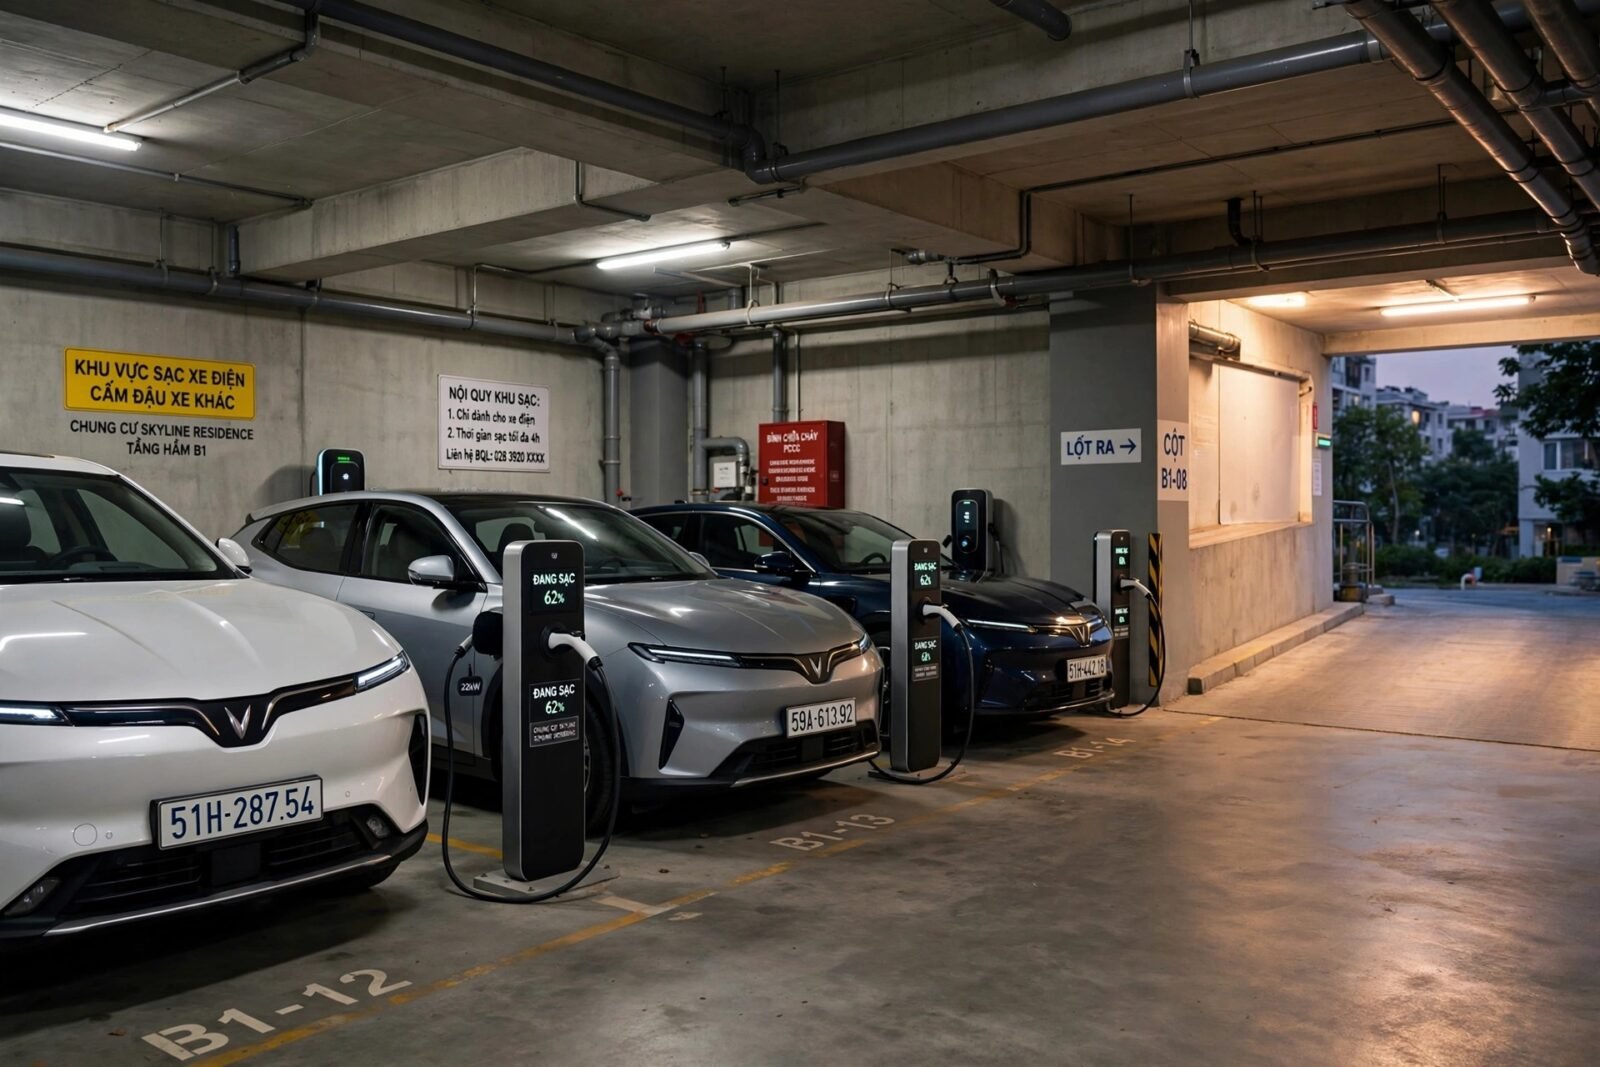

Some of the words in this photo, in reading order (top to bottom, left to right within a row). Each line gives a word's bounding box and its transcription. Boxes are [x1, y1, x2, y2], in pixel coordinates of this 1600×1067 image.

[75, 359, 110, 377] KHU
[115, 362, 149, 383] VỰC
[153, 366, 185, 385] SẠC
[189, 368, 207, 385] XE
[212, 368, 245, 390] ĐIỆN
[90, 380, 128, 403] CẤM
[133, 386, 166, 408] ĐẬU
[171, 391, 190, 407] XE
[195, 391, 235, 410] KHÁC
[449, 384, 468, 403] NỘI
[470, 389, 492, 402] QUY
[495, 391, 515, 405] KHU
[518, 393, 540, 409] SẠC:
[448, 408, 455, 420] 1.
[493, 411, 506, 423] cho
[508, 415, 517, 424] xe
[70, 420, 116, 435] CHUNG
[120, 421, 138, 435] CƯ
[141, 423, 190, 437] SKYLINE
[193, 426, 254, 440] RESIDENCE
[447, 427, 455, 439] 2.
[531, 433, 540, 443] 4h
[194, 445, 206, 456] B1
[1096, 439, 1115, 455] RA
[1163, 427, 1185, 462] CỘT
[508, 451, 525, 462] 3920
[1161, 467, 1187, 490] B1-08
[532, 573, 557, 586] ĐANG
[558, 572, 576, 587] SẠC
[544, 590, 565, 605] 62%
[532, 686, 557, 699] ĐANG
[558, 684, 576, 698] SẠC
[545, 700, 565, 715] 62%
[791, 703, 853, 732] 59A-613.92
[171, 786, 315, 839] 51H-287.54
[770, 814, 895, 851] B1-13
[141, 969, 413, 1061] B1-12
